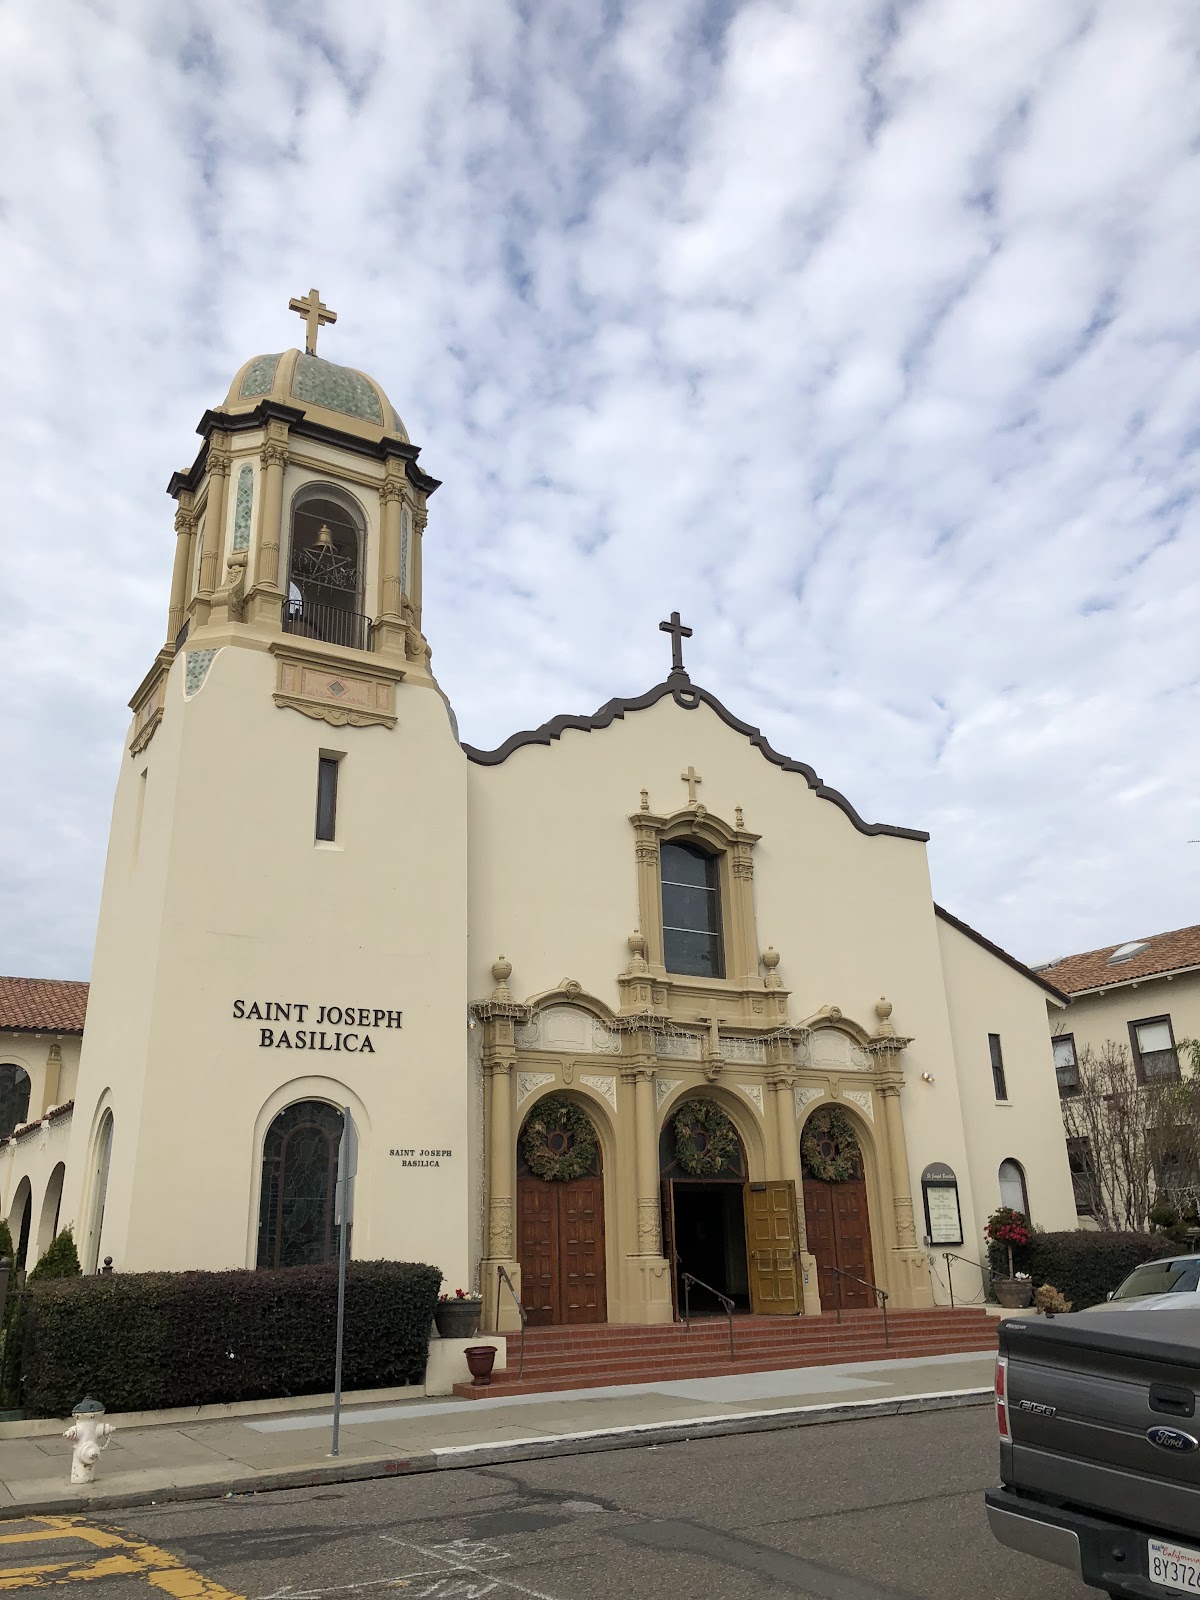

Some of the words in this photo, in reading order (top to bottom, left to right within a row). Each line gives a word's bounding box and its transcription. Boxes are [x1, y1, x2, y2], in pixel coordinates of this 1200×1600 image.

[233, 999, 309, 1023] SAINT
[316, 1005, 403, 1029] JOSEPH
[259, 1028, 376, 1053] BASILICA
[389, 1149, 415, 1157] SAINT
[419, 1149, 452, 1158] JOSEPH
[401, 1160, 440, 1168] BASILICA
[1155, 1430, 1183, 1448] Ford
